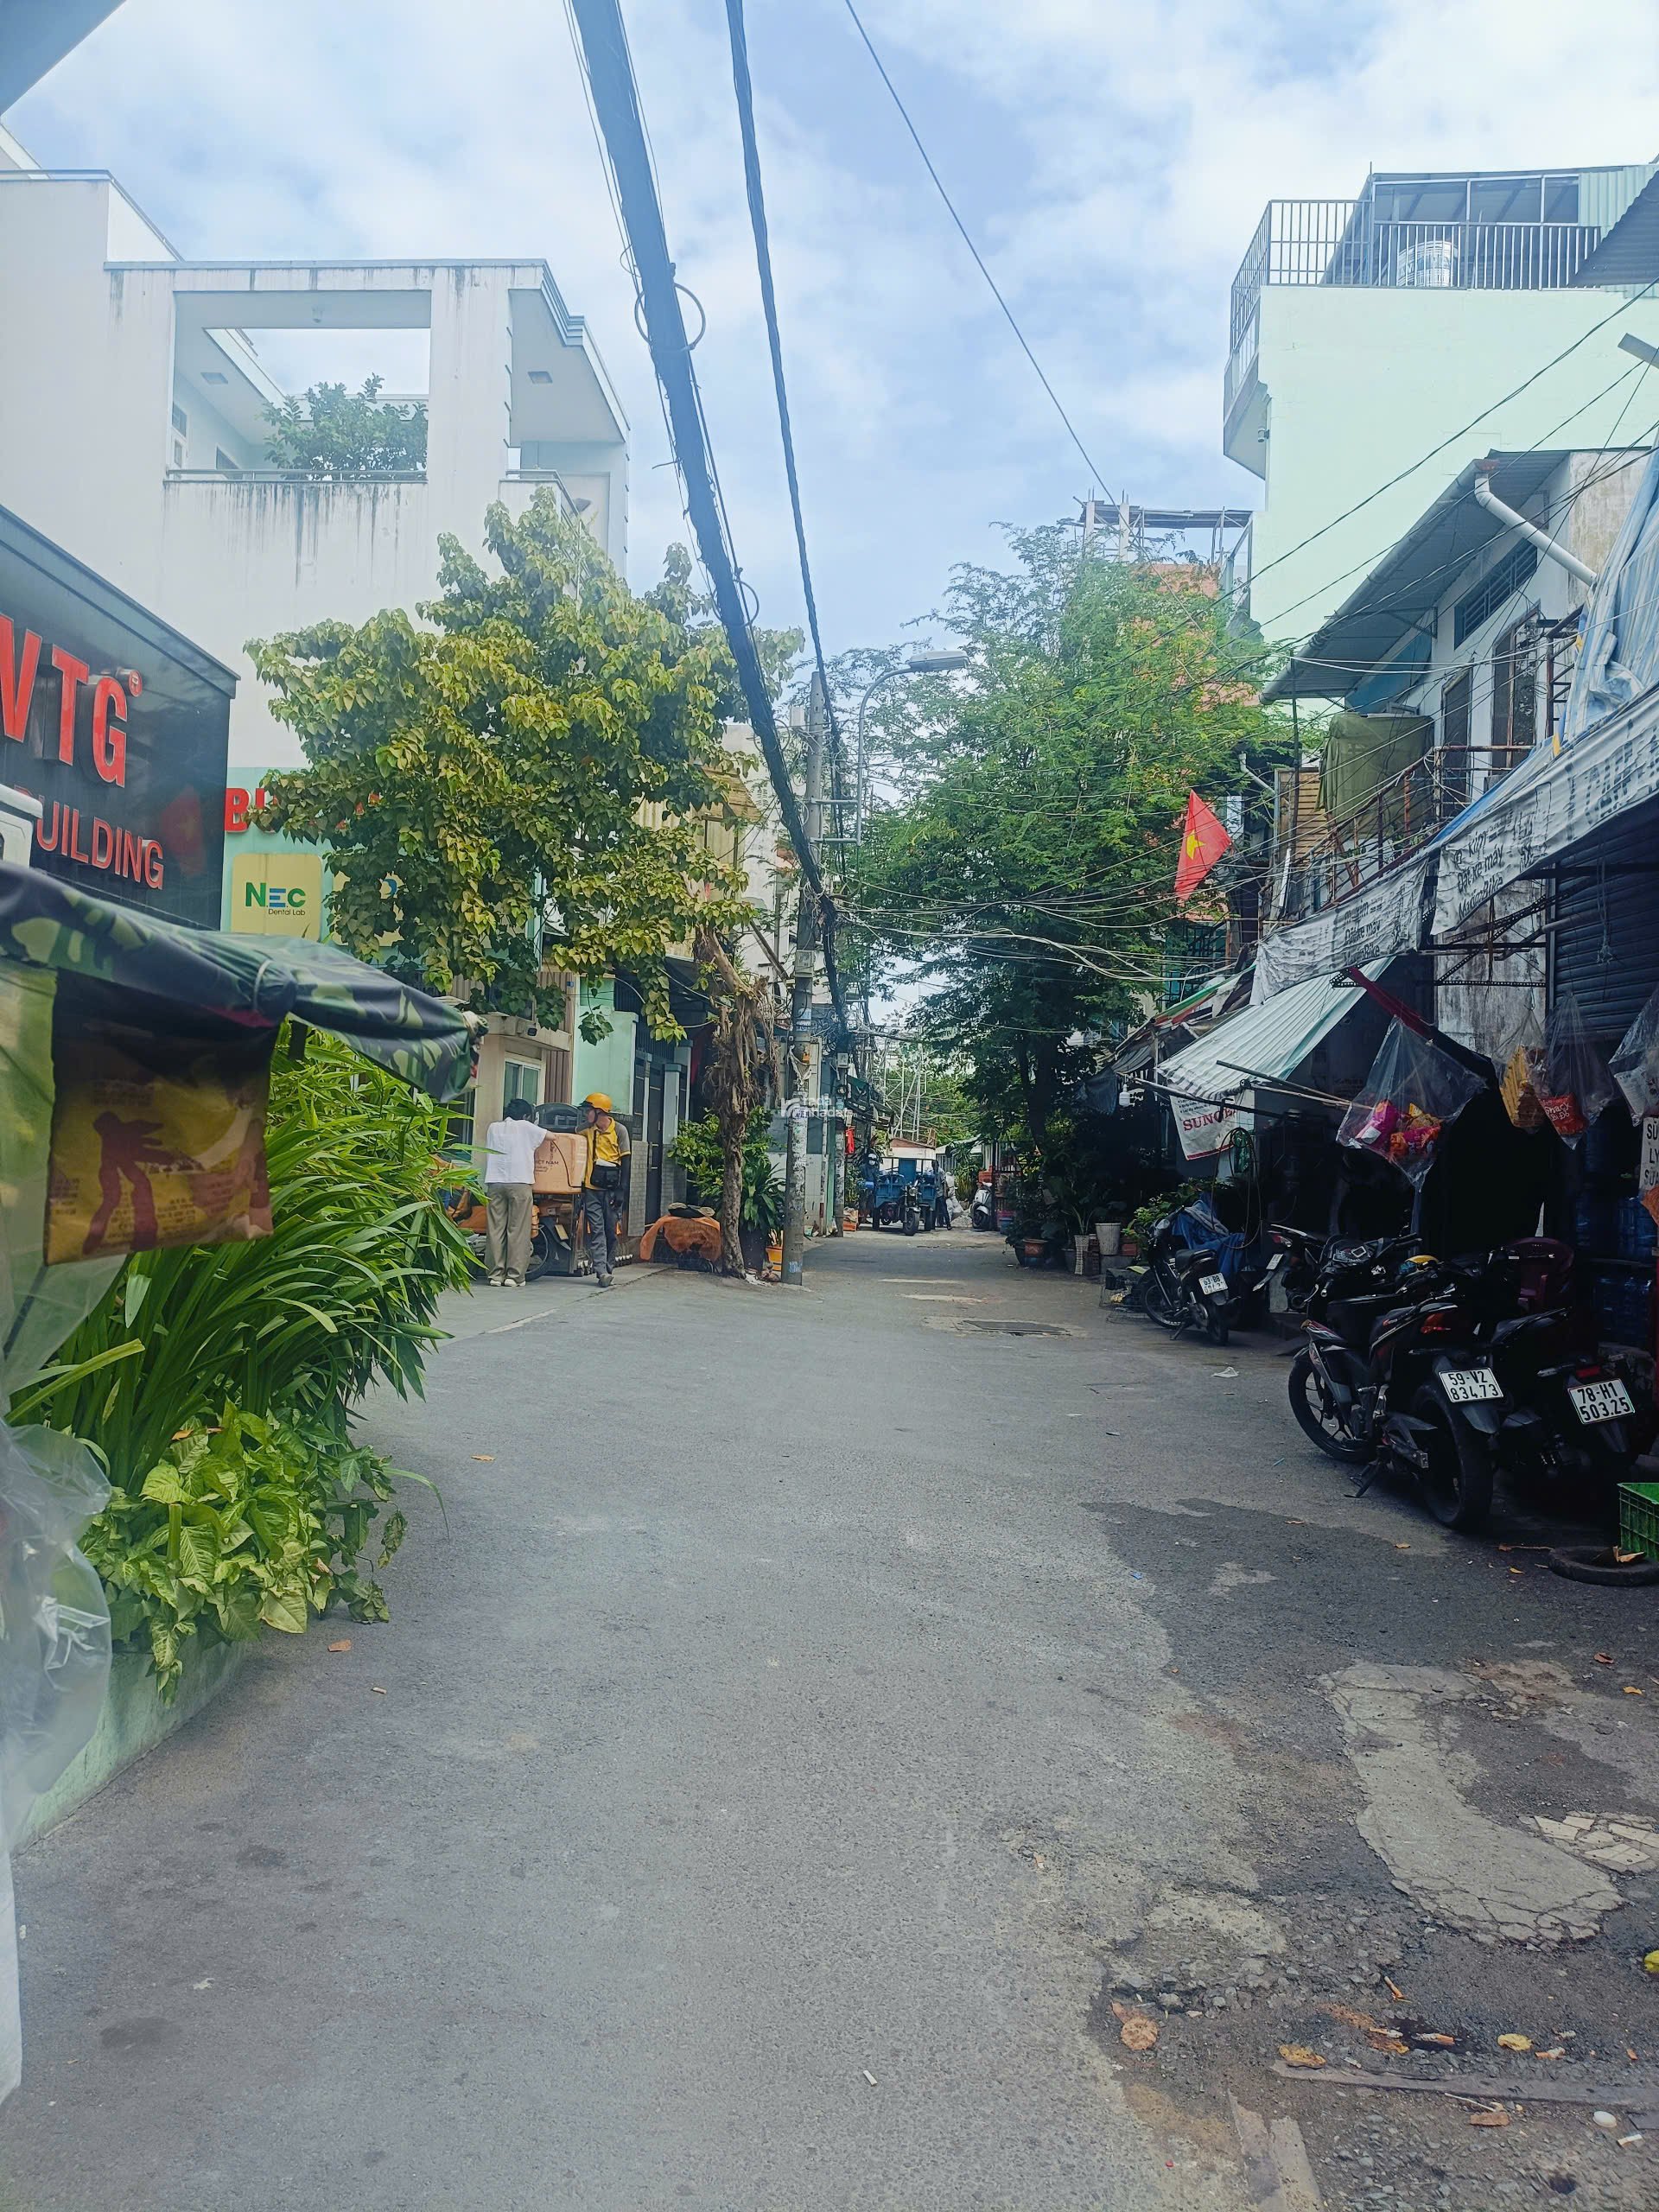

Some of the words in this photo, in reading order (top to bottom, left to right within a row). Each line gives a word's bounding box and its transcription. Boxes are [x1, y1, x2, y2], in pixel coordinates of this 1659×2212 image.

[14, 785, 163, 890] UILDING
[1447, 1370, 1487, 1386] 59-V2
[1450, 1383, 1499, 1401] 834.73
[1577, 1382, 1618, 1404] 78-H1
[1580, 1396, 1631, 1421] 503.25
